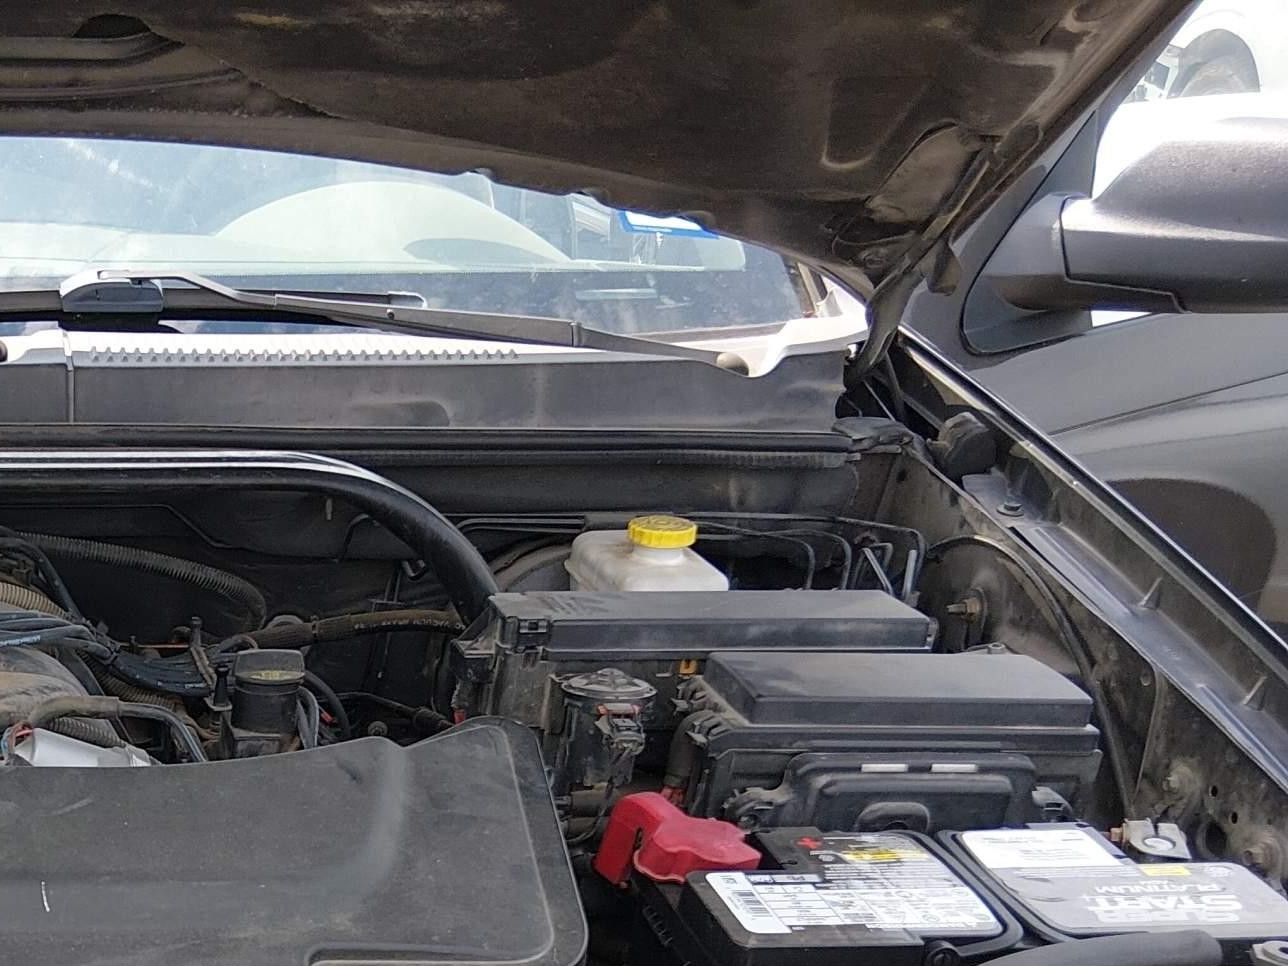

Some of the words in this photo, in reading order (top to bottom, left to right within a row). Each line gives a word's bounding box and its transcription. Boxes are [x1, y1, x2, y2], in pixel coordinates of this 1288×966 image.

[1096, 884, 1224, 893] PLATINUM
[1086, 895, 1242, 910] START
[1097, 910, 1240, 922] SUPER
